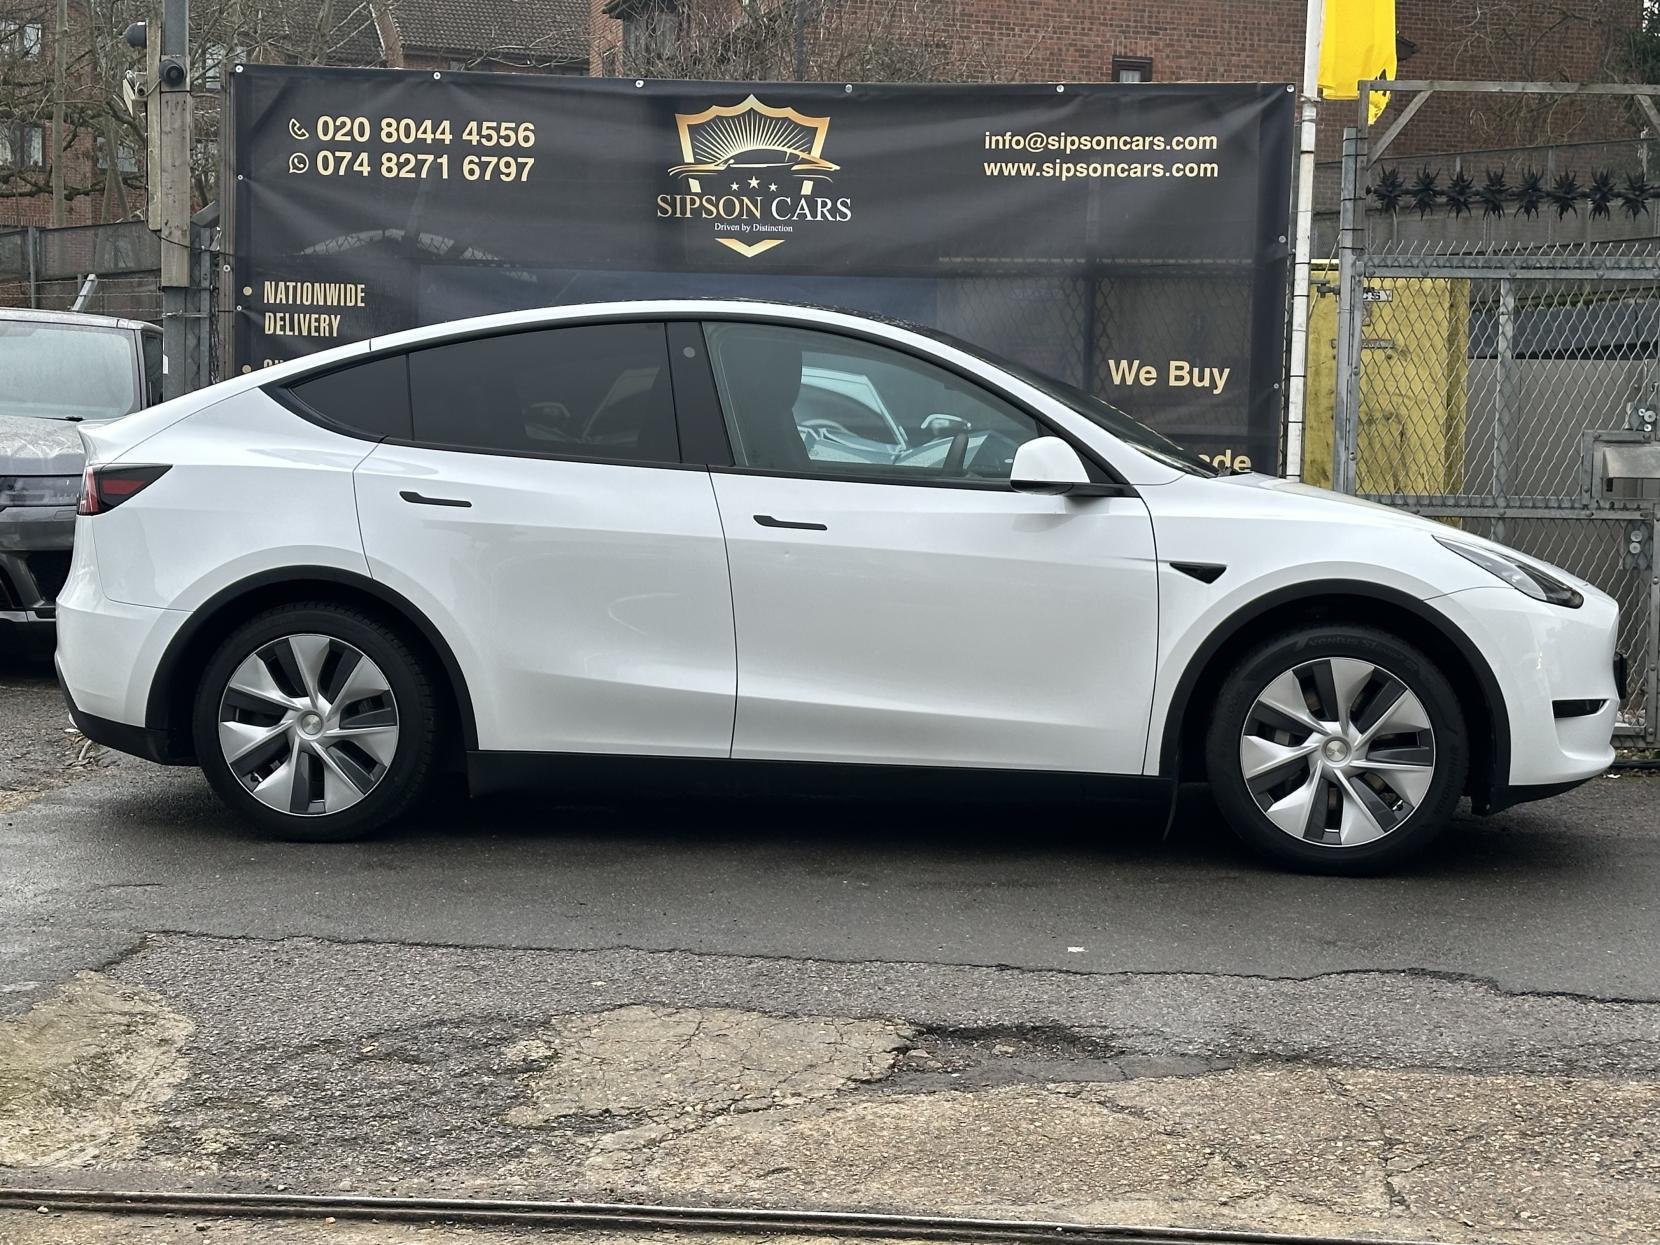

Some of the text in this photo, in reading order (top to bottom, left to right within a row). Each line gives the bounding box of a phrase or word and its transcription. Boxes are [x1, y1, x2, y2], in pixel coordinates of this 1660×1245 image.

[316, 115, 536, 148] 020 8044 4556
[984, 131, 1218, 155] info@sipsoncars.com
[316, 150, 535, 182] 074 8271 6797
[983, 159, 1219, 182] www.sipsoncars.com
[656, 194, 852, 222] SIPSON CARS
[714, 222, 793, 233] Driven by Distinction
[263, 280, 366, 307] NATIONWIDE
[264, 312, 341, 338] DELIVERY
[1107, 359, 1231, 395] We Buy
